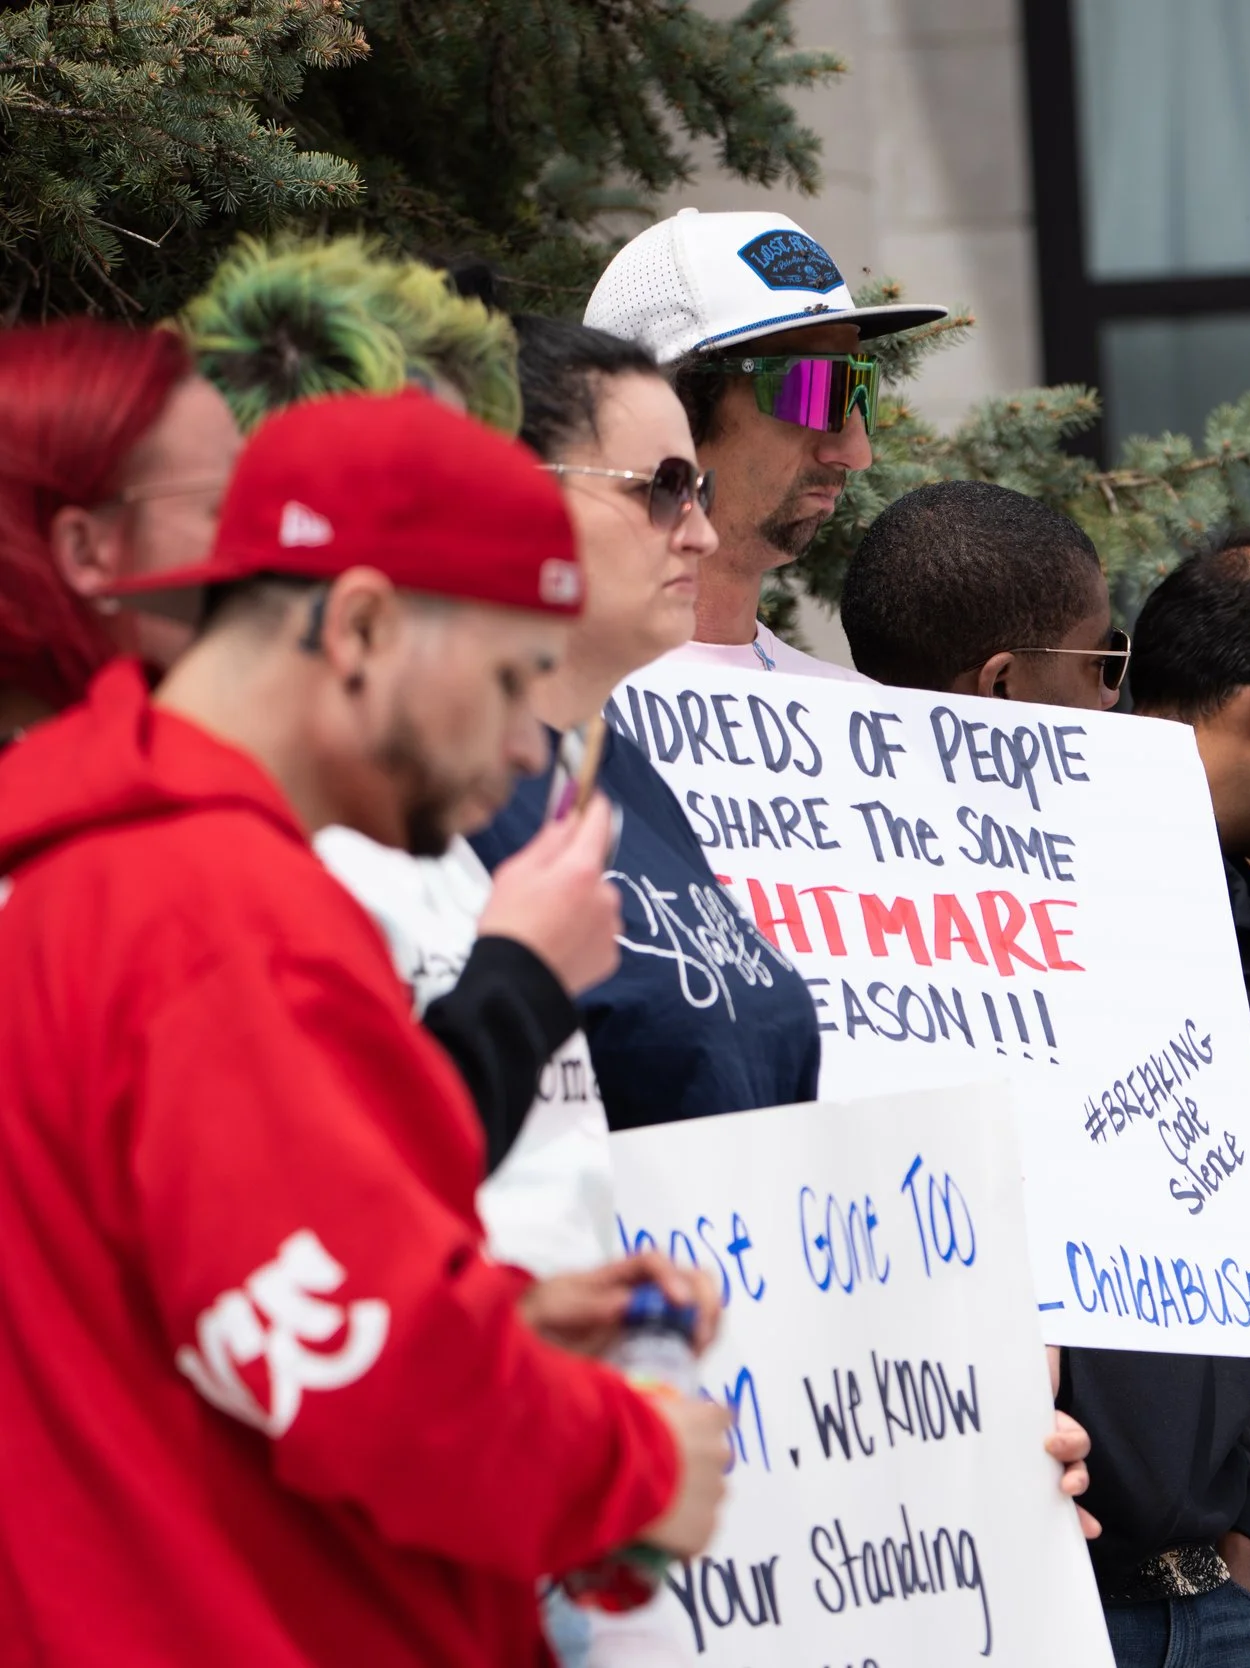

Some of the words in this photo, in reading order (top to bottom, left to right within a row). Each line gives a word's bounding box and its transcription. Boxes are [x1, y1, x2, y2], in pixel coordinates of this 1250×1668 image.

[849, 711, 908, 780] OF
[687, 790, 842, 851] SHARE
[850, 800, 945, 867] The
[715, 873, 1086, 977] HTMARE
[1084, 1018, 1214, 1144] #BREAKING
[1157, 1094, 1210, 1166] Code
[1169, 1130, 1245, 1216] Silence
[811, 1503, 993, 1657] Standing
